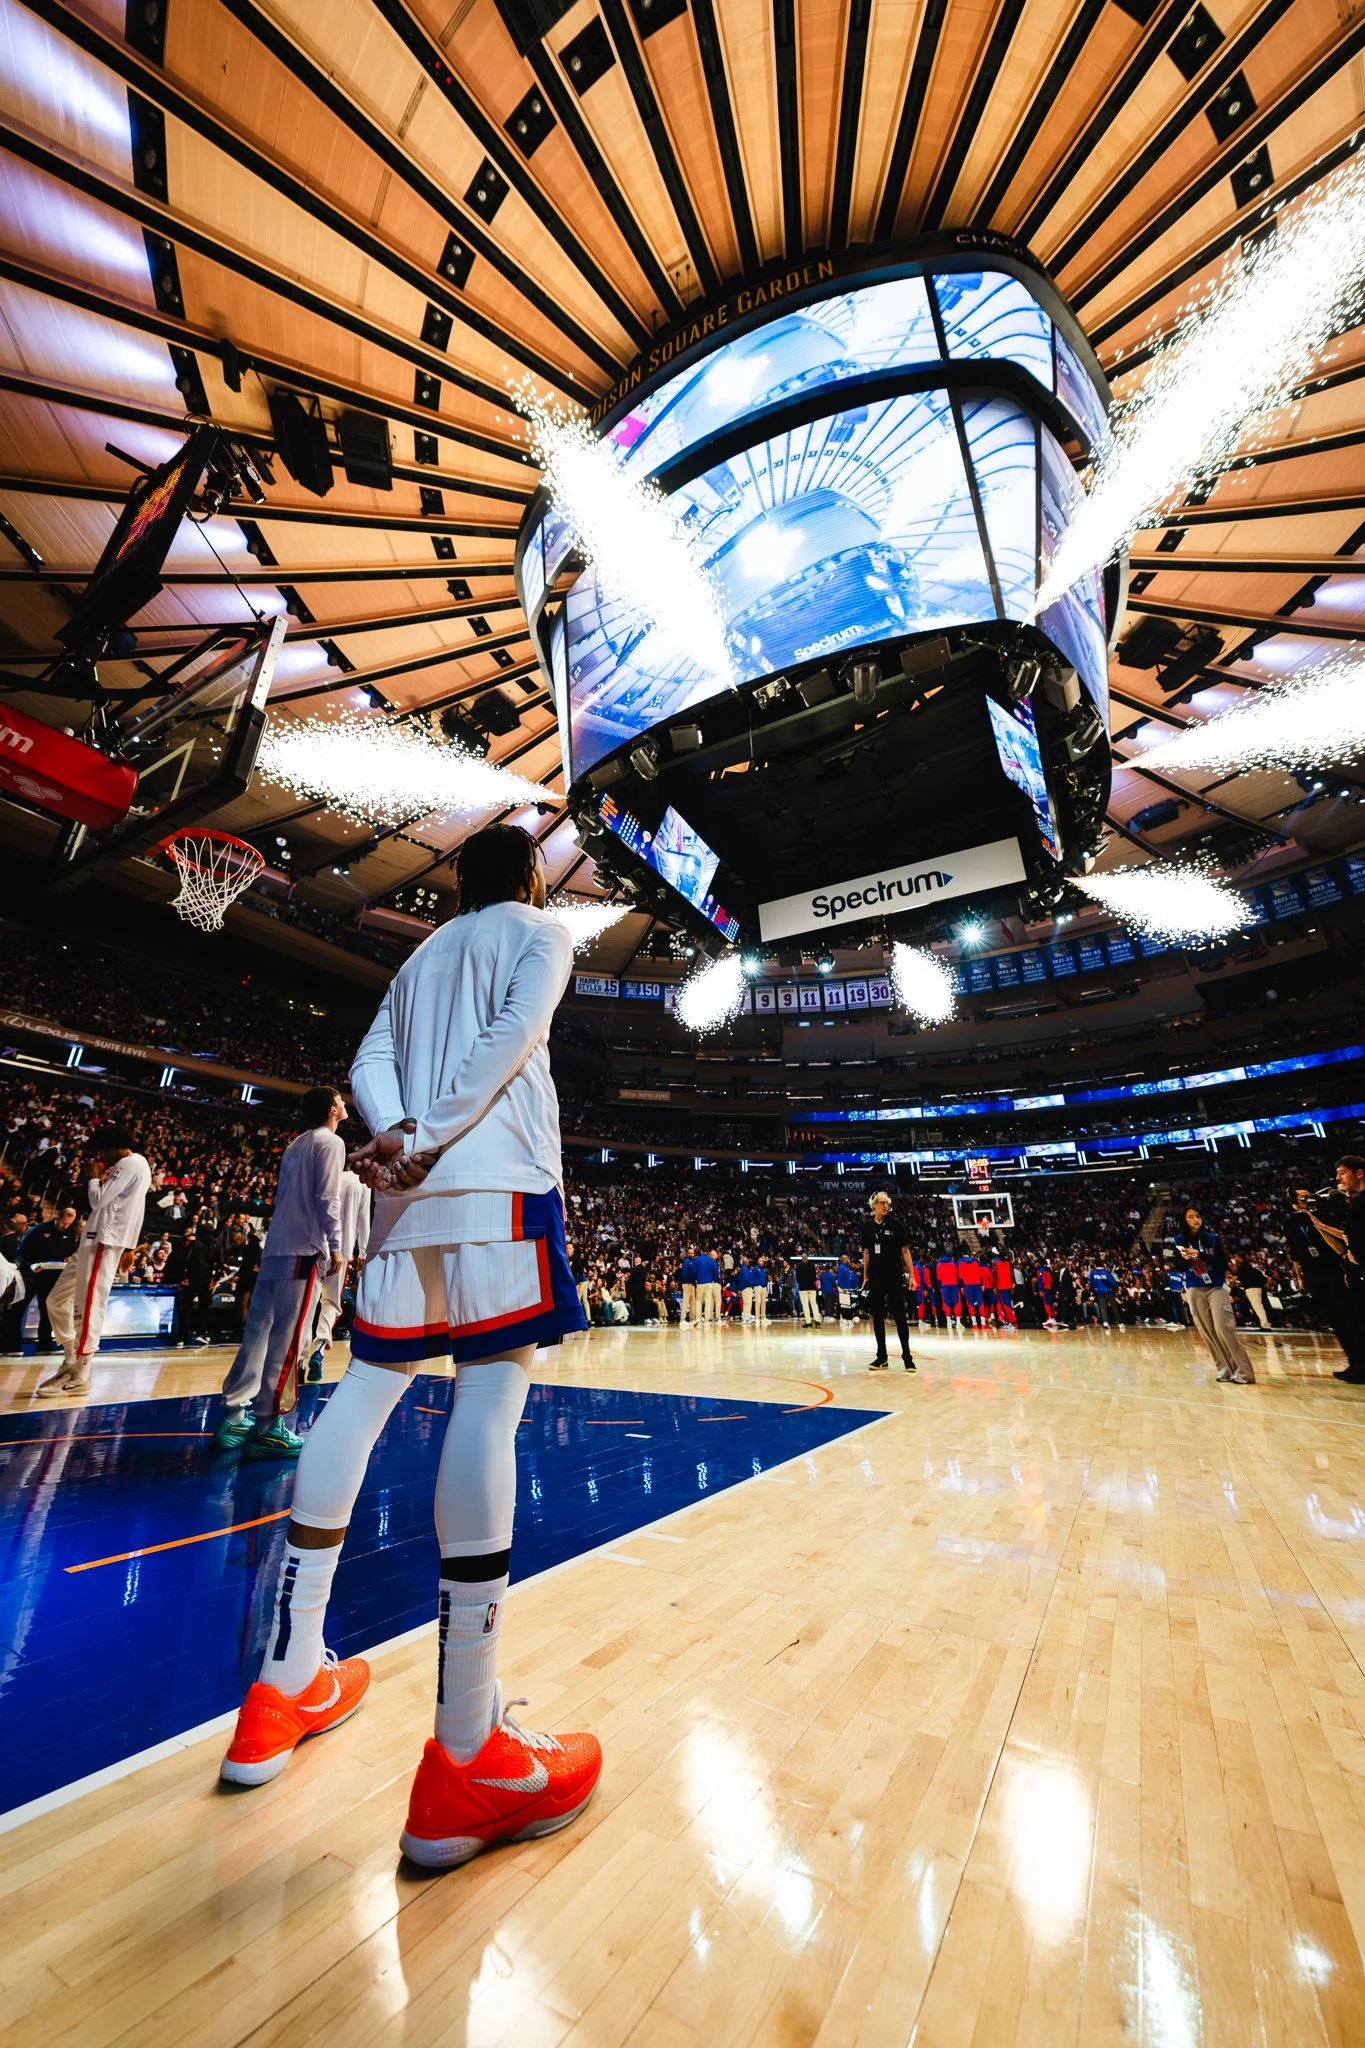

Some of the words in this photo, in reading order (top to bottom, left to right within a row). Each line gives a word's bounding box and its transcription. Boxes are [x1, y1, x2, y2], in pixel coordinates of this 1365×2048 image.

[592, 364, 641, 425] DISON
[648, 304, 728, 373] SQUARE
[737, 259, 834, 313] GARDEN
[794, 624, 866, 661] Spectrum
[811, 870, 944, 920] Spectrum
[577, 983, 602, 991] STYLES
[579, 977, 601, 985] HARRY
[604, 980, 618, 993] 15
[639, 984, 660, 996] 150
[850, 989, 866, 1003] 19
[871, 986, 889, 1000] 30
[761, 995, 770, 1007] 9
[784, 994, 793, 1006] 9
[804, 993, 817, 1006] 11
[828, 991, 842, 1005] 11
[25, 1022, 80, 1041] LEXUS
[94, 1040, 120, 1053] SUITE
[121, 1047, 148, 1058] LEVEL
[970, 1166, 989, 1178] 24
[842, 1181, 866, 1190] YORK
